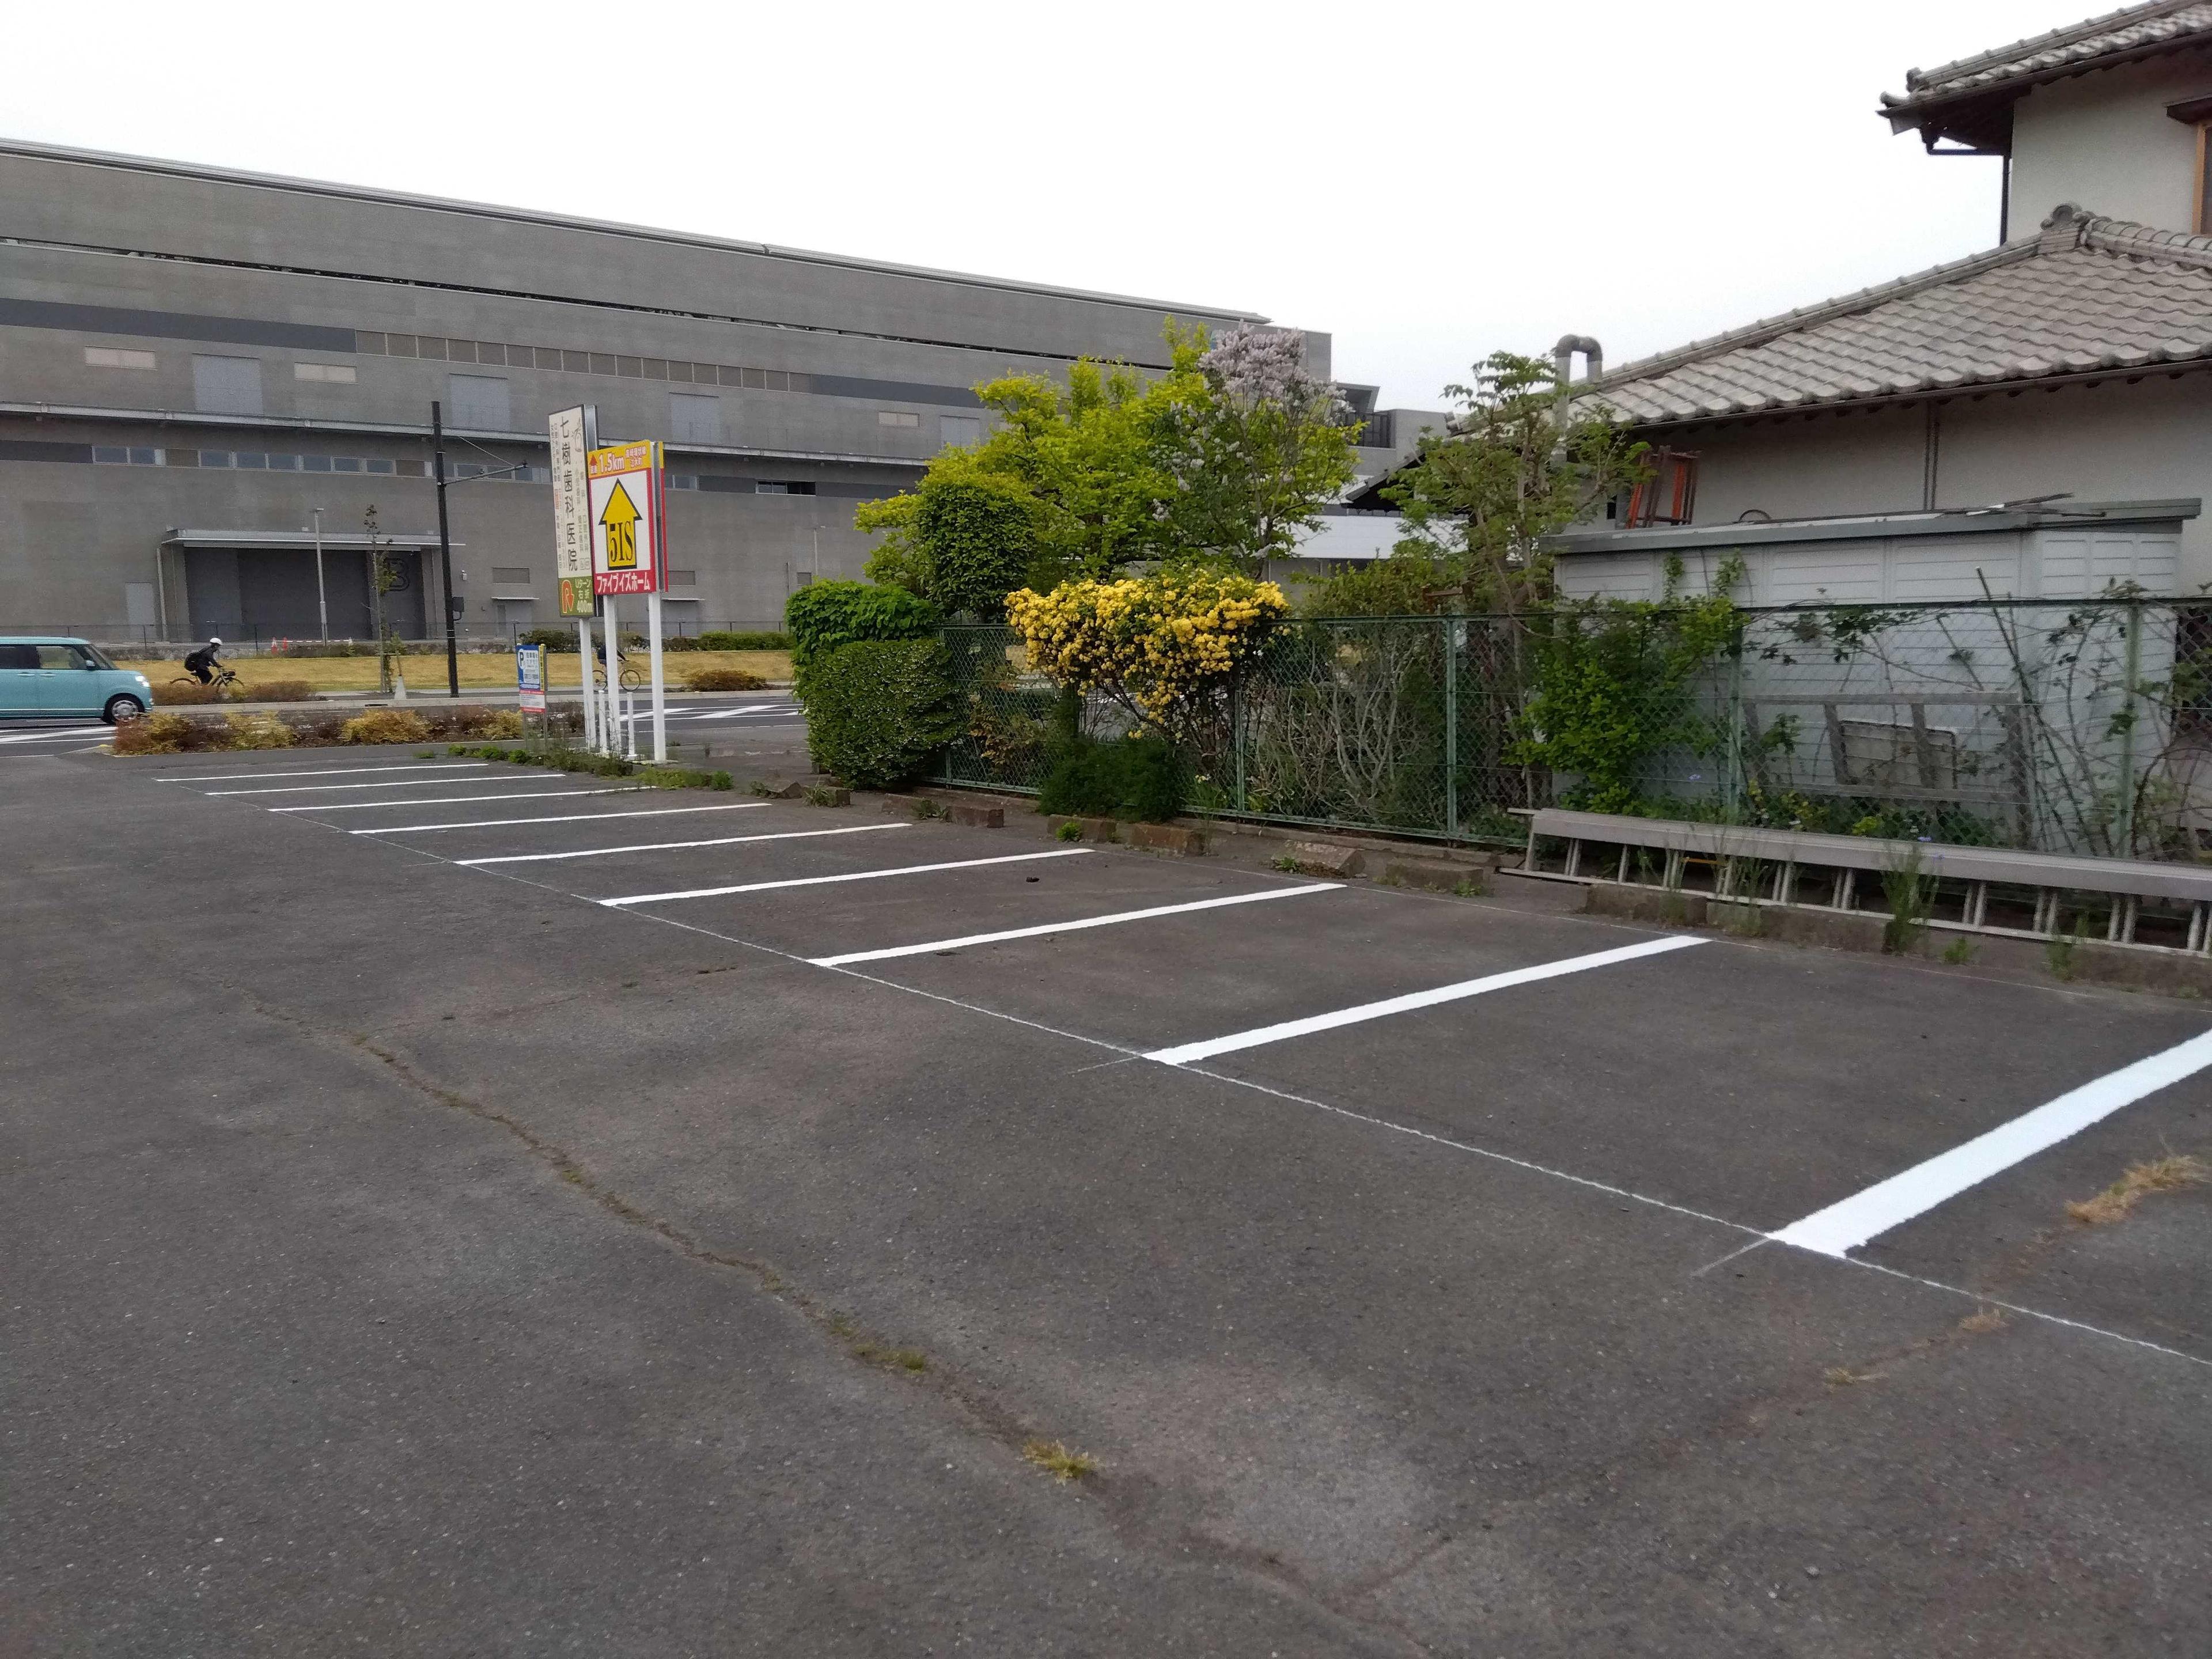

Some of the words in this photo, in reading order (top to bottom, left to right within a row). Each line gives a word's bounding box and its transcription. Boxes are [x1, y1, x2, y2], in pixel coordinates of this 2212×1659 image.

[599, 453, 624, 473] 1.5km
[575, 579, 591, 588] Uターン
[597, 572, 650, 593] ファイブイズホーム
[577, 600, 593, 613] 400m
[519, 652, 524, 666] P
